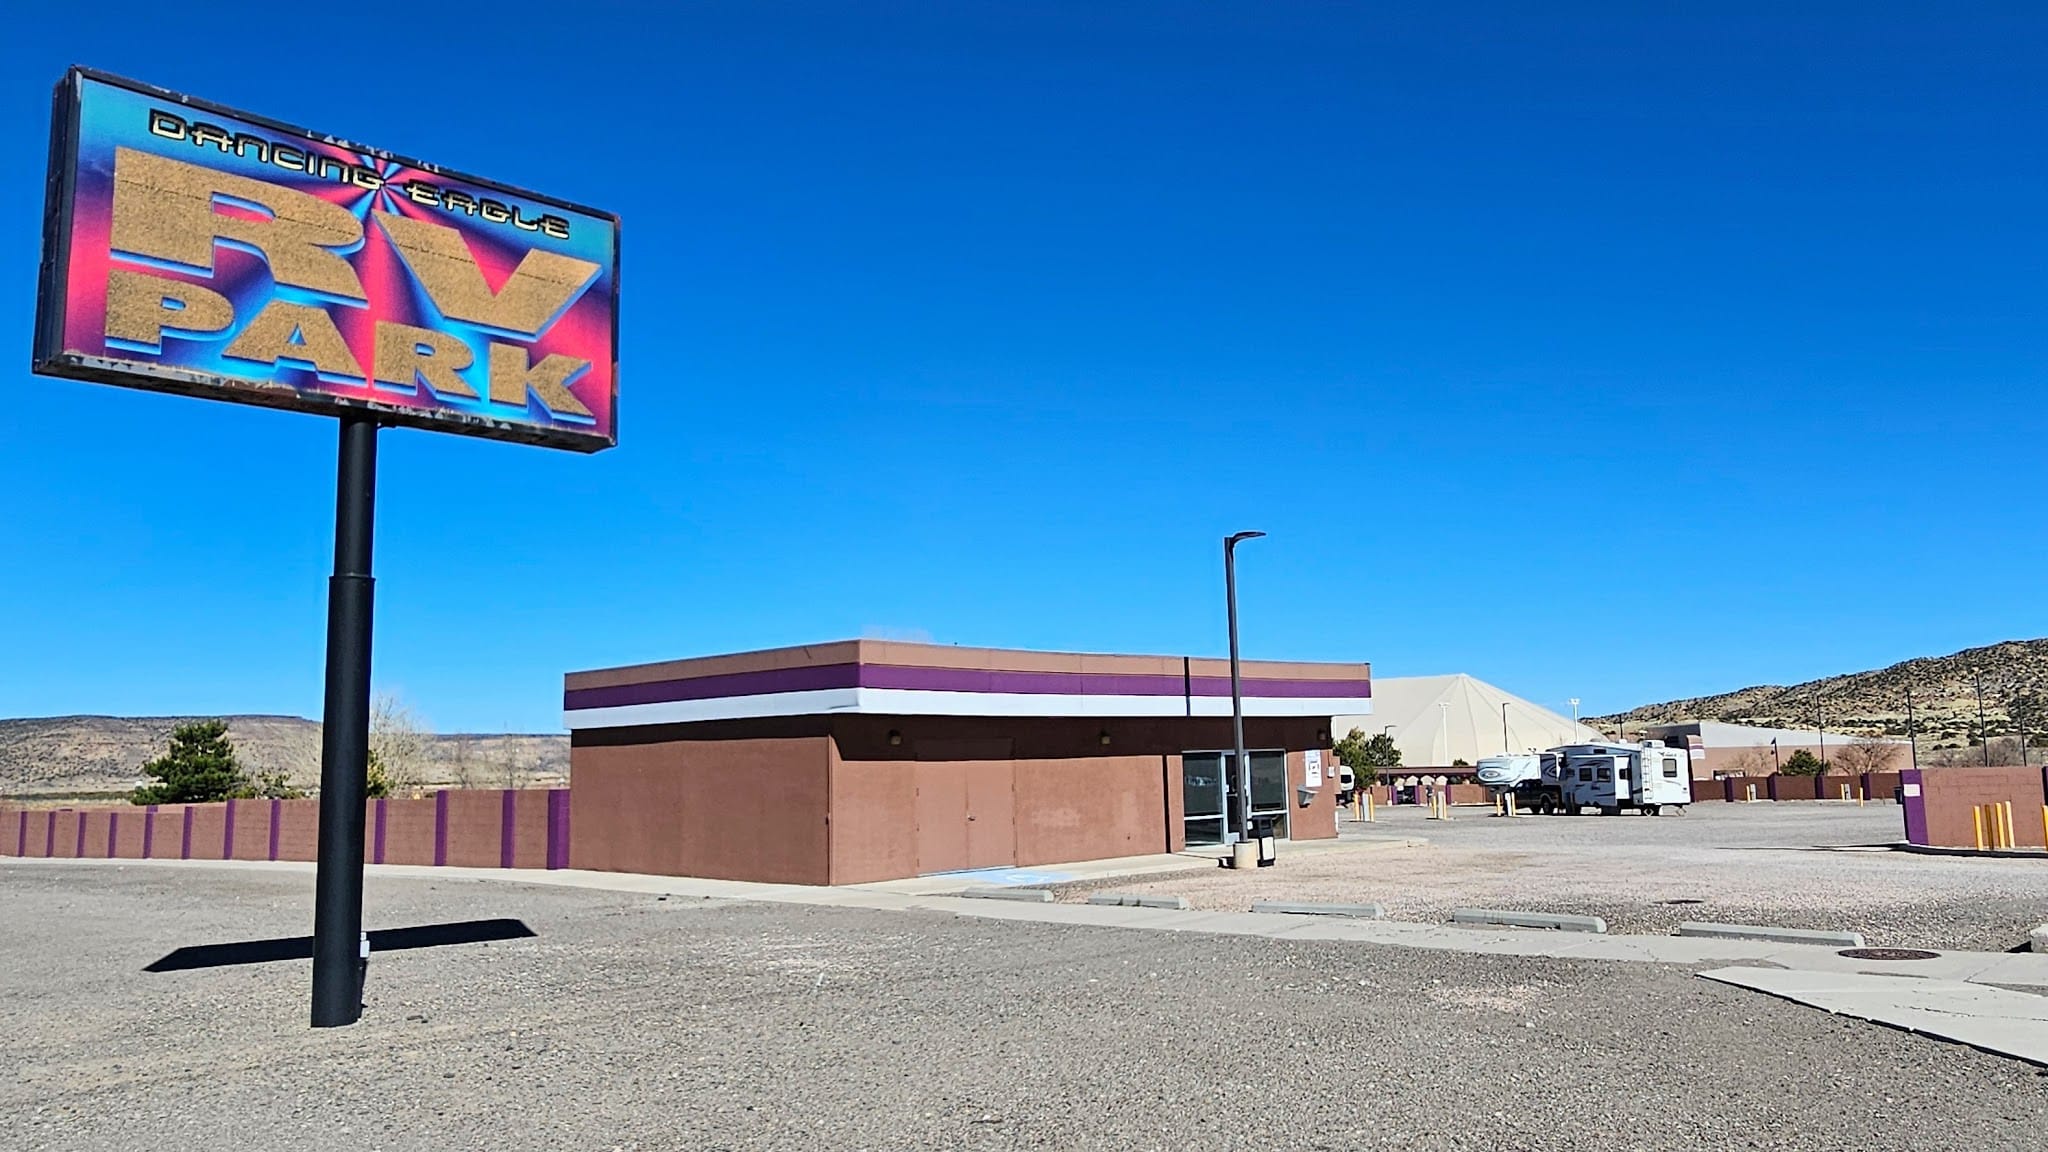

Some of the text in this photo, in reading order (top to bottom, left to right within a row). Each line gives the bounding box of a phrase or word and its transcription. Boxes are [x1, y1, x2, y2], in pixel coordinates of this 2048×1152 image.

[110, 146, 601, 342] RV
[149, 108, 571, 239] DANCING EAGLE
[105, 268, 597, 425] PARK
